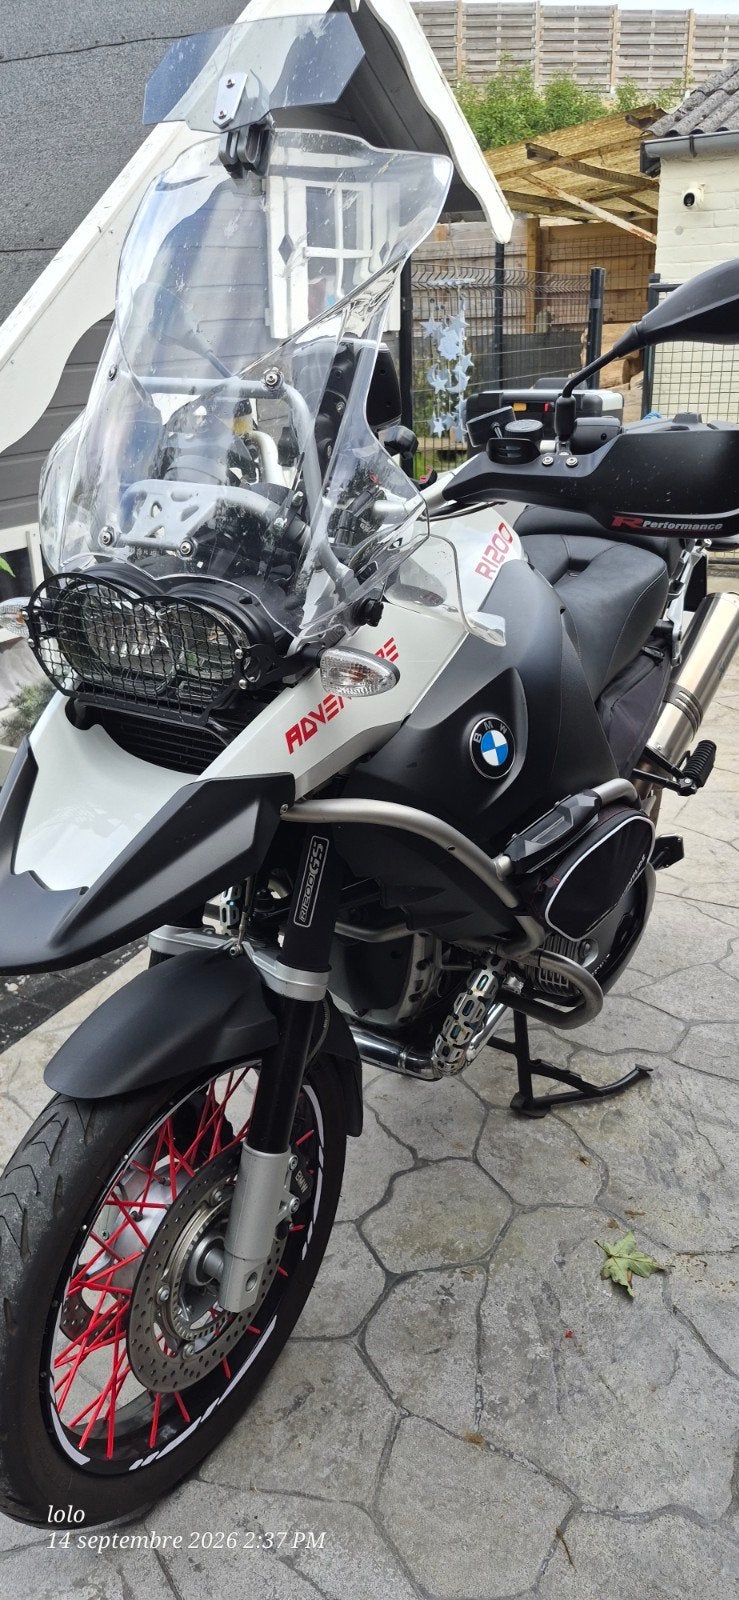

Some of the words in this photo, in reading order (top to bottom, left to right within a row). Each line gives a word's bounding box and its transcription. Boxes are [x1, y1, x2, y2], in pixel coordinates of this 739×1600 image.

[475, 522, 513, 580] R1200
[472, 720, 508, 744] BMW
[295, 1170, 309, 1194] BMW
